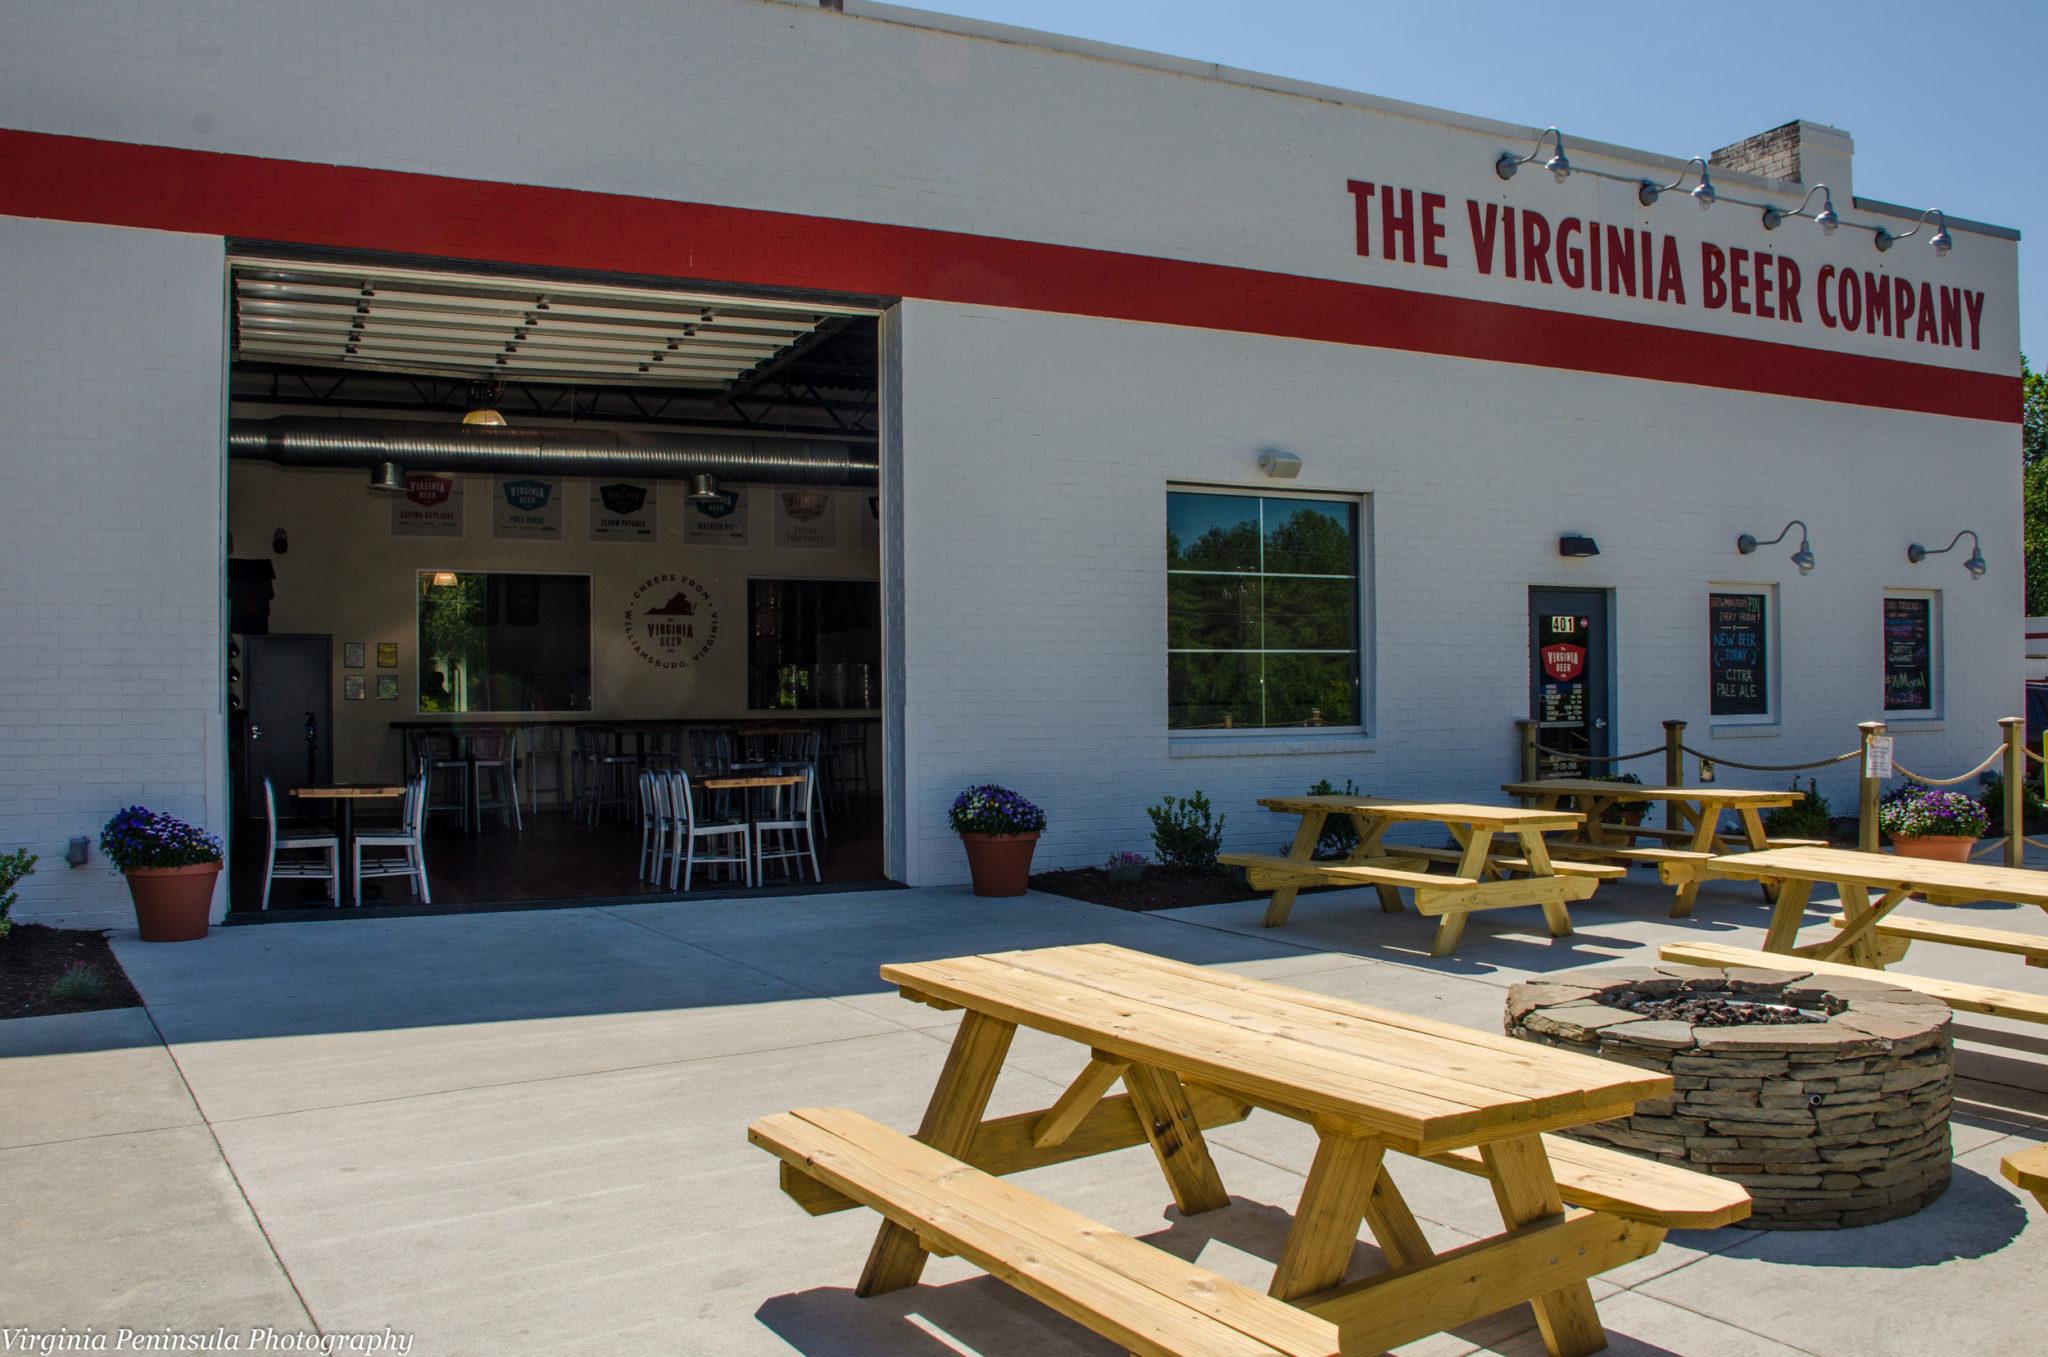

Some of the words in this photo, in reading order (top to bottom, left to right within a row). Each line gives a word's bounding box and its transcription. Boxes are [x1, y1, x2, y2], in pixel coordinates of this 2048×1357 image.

[1346, 178, 1448, 269] THE
[1466, 200, 1687, 306] VIRGINIA
[1701, 241, 1802, 324] BEER
[1815, 263, 1986, 351] COMPANY
[409, 480, 446, 494] VIRGINIA
[509, 486, 545, 499] VIRGINIA
[633, 574, 676, 599] CHEERS
[681, 576, 711, 601] FROM
[647, 623, 694, 638] VIRGINIA
[1553, 616, 1573, 632] 401
[660, 637, 682, 647] BEER
[692, 611, 718, 662] VIRGINIA
[1714, 633, 1736, 646] NEW
[1738, 633, 1755, 646] BEER
[1547, 651, 1579, 665] VIRGINIA
[1725, 649, 1747, 661] TODAY
[1555, 663, 1572, 673] BEER
[1726, 669, 1752, 681] CITRA
[1716, 683, 1736, 697] PALE
[1739, 685, 1757, 697] ALE
